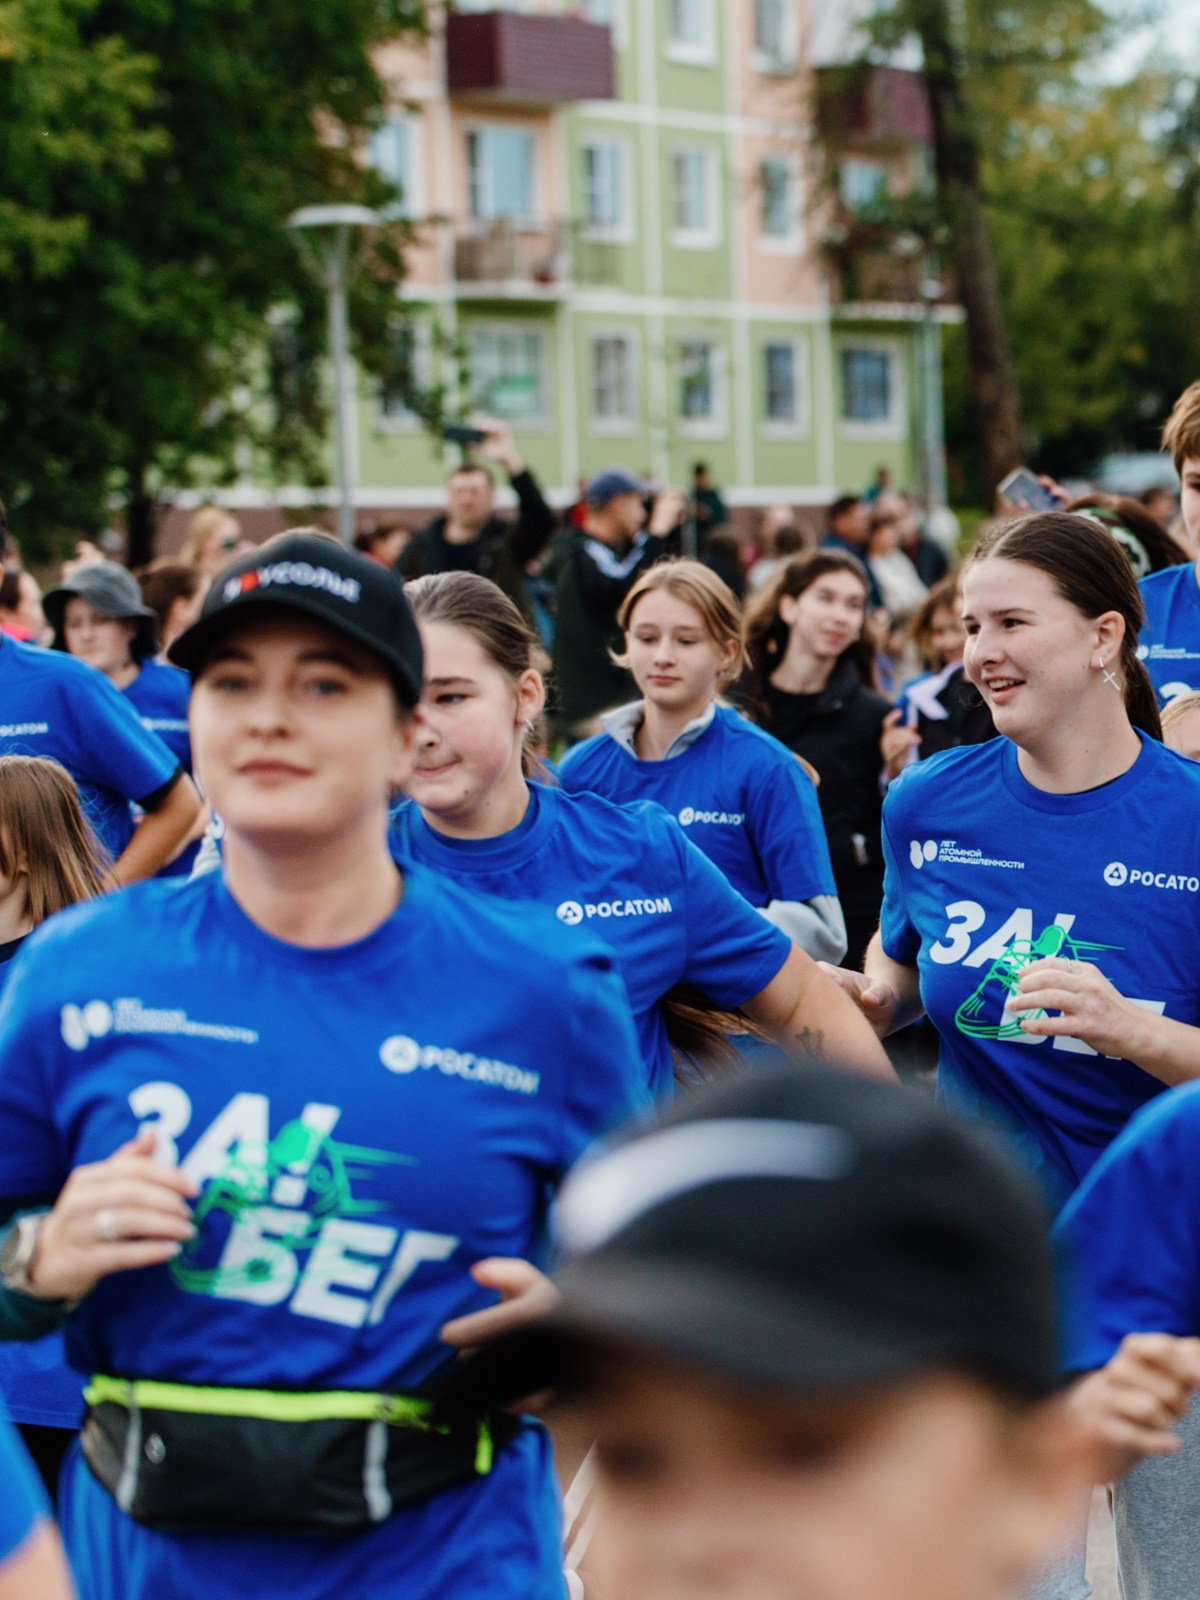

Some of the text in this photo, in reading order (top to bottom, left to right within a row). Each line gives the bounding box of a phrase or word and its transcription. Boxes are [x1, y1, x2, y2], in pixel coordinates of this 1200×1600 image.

[938, 848, 982, 858] АТОМНОЙ
[940, 840, 957, 849] ЛЕТ
[938, 856, 1025, 870] ПРОМЫШЛЕННОСТИ
[583, 896, 672, 919] РОСАТОМ
[420, 1044, 541, 1097] РОСАТОМ
[210, 1205, 461, 1329] БЕГ
